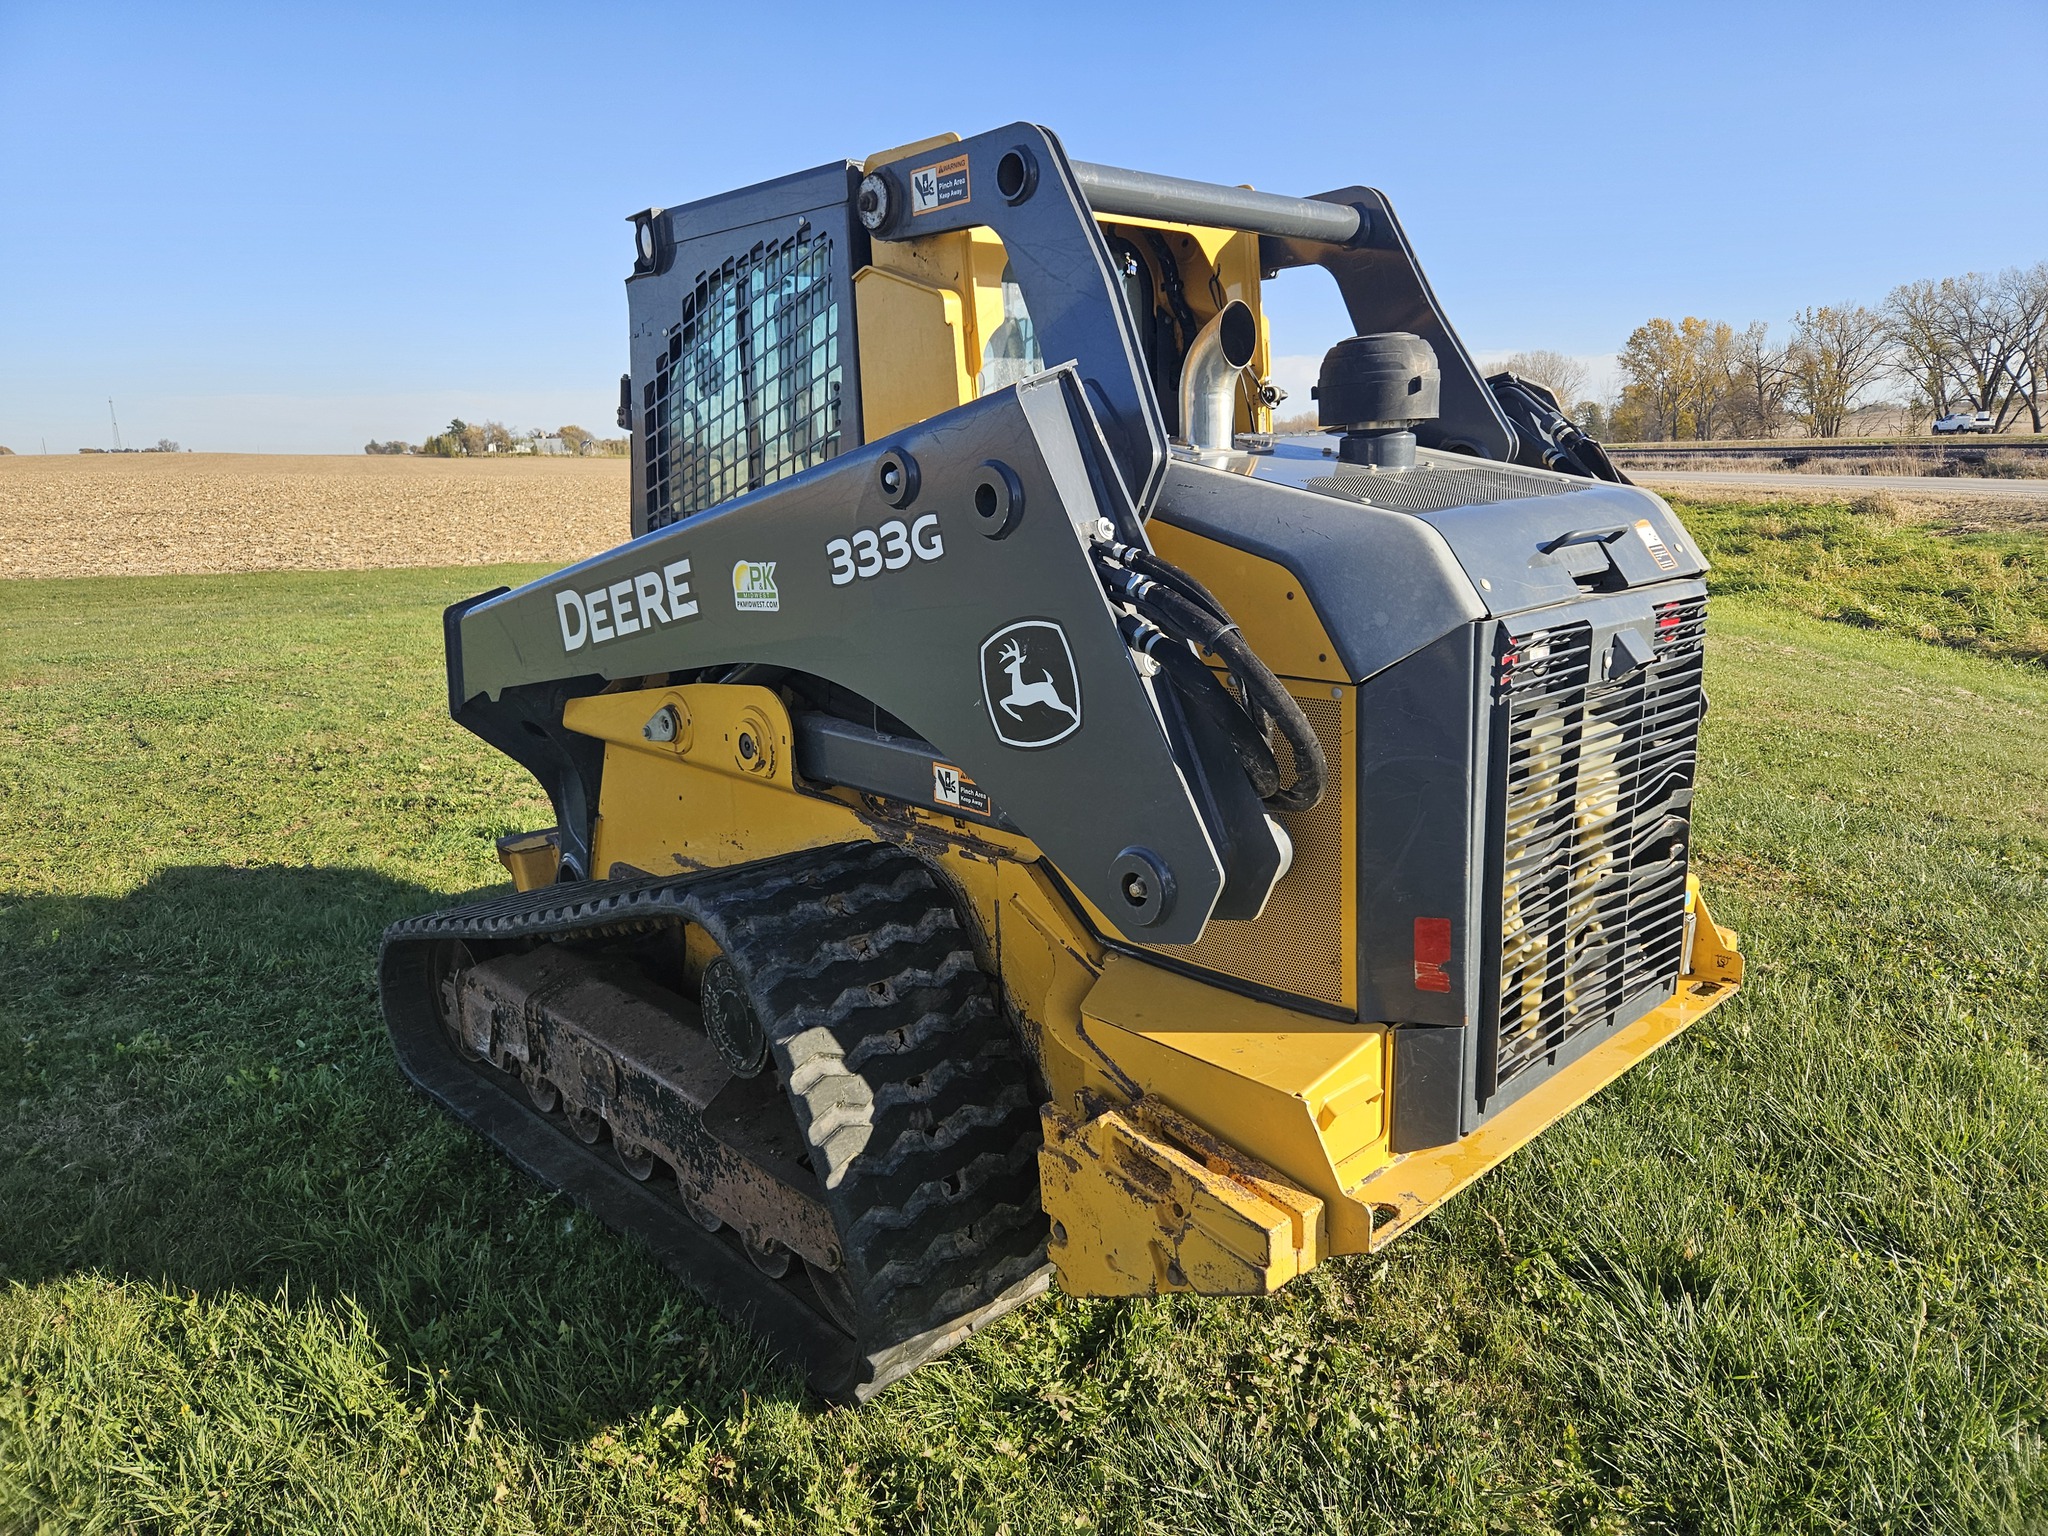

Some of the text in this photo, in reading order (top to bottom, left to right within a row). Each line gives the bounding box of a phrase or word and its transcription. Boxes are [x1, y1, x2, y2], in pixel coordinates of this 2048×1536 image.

[944, 160, 965, 171] WARNING
[938, 177, 966, 191] Pinch Area
[939, 188, 963, 200] Keep Away
[826, 514, 944, 586] 333G
[555, 558, 699, 652] DEERE
[961, 787, 986, 799] Pinch Area
[972, 799, 983, 807] Away
